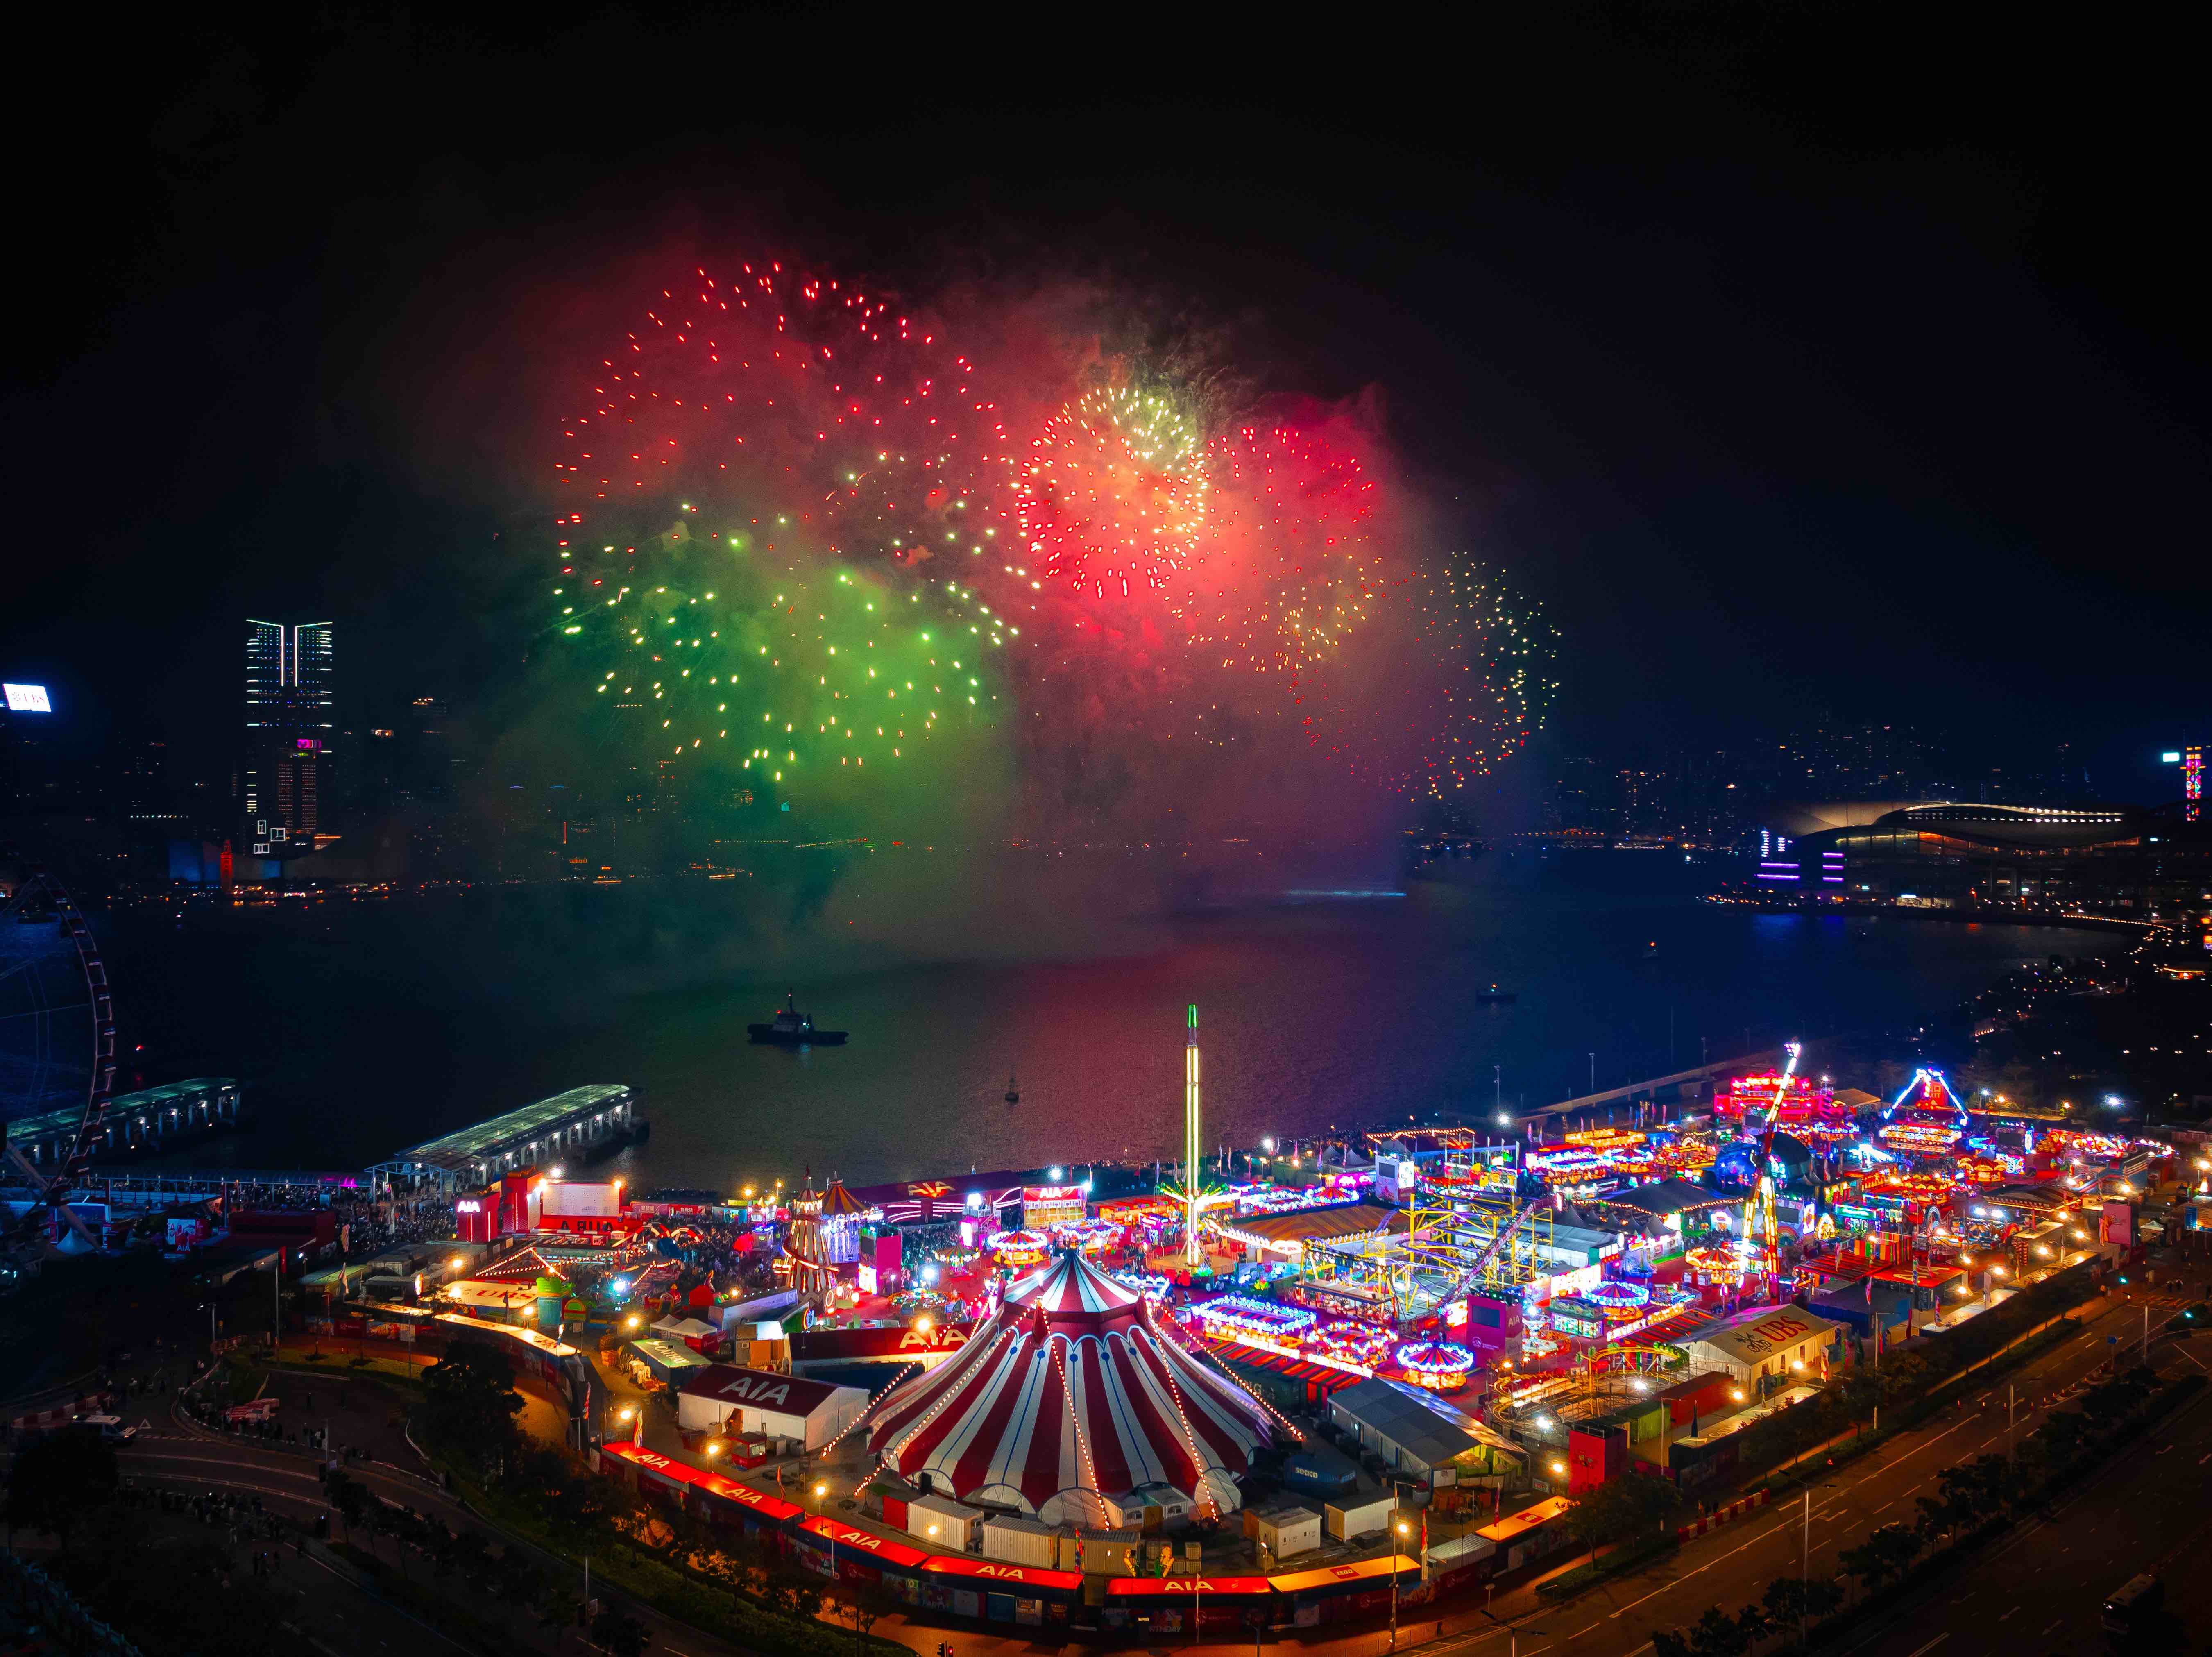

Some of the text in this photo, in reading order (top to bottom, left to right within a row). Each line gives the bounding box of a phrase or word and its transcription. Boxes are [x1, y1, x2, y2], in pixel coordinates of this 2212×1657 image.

[1039, 1187, 1062, 1198] AIA
[457, 1201, 480, 1213] AIA
[1508, 1316, 1520, 1327] AIA
[1752, 1316, 1809, 1341] UBS
[899, 1329, 970, 1348] AIA
[718, 1376, 790, 1405] AIA
[635, 1454, 670, 1469] AIA
[726, 1488, 763, 1505] AIA
[840, 1532, 882, 1550] AIA
[976, 1565, 1024, 1580] AIA
[1164, 1581, 1214, 1591] AIA
